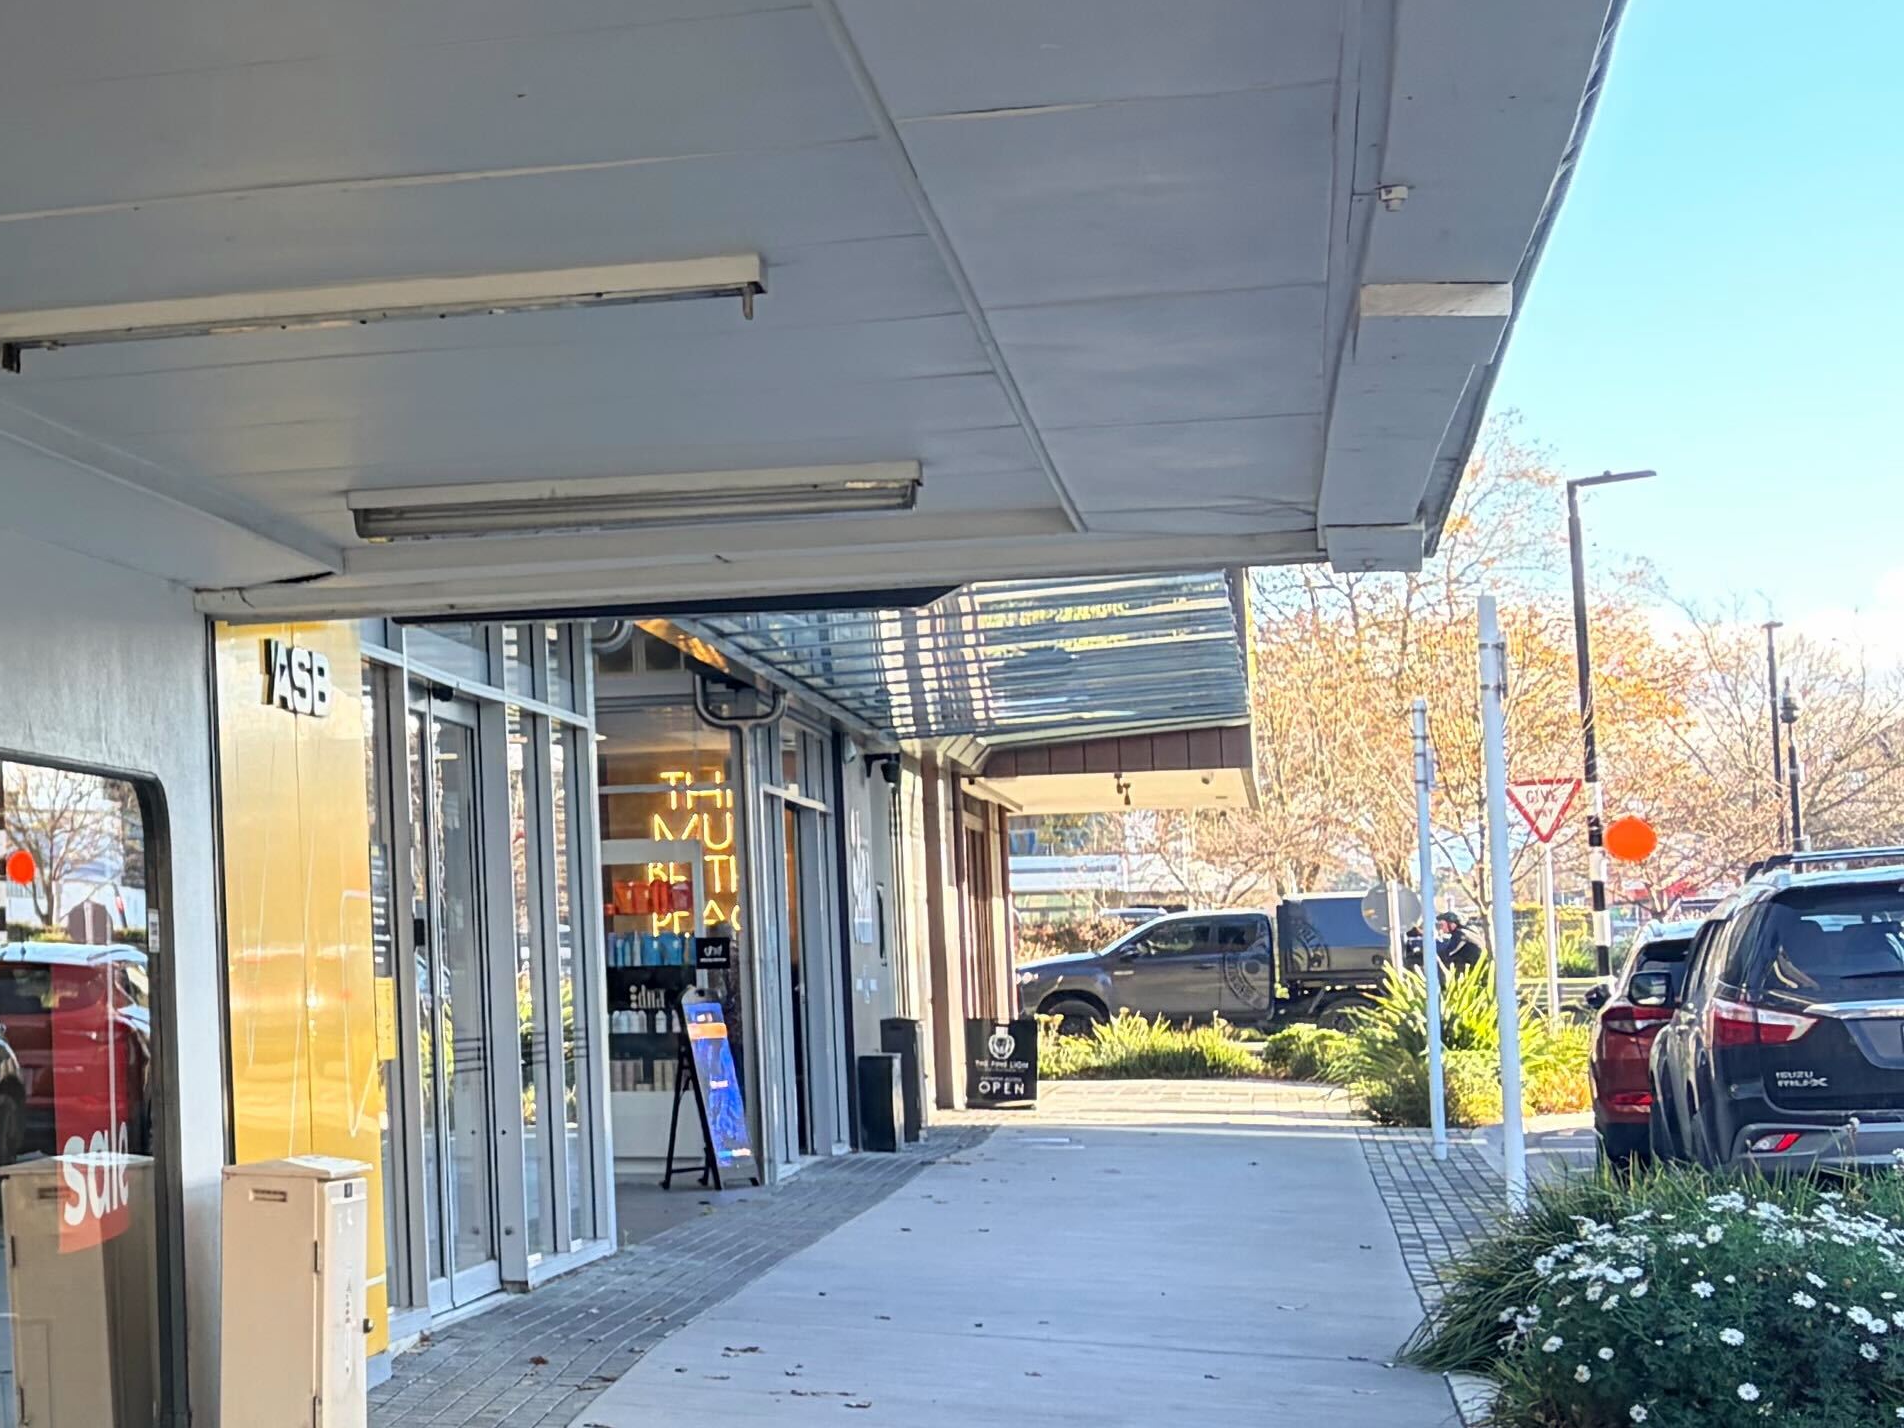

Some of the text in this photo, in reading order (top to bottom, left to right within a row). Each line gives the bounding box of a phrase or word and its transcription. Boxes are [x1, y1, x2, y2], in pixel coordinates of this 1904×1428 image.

[270, 640, 332, 717] ASB
[978, 1081, 1025, 1095] OPEN
[63, 1121, 129, 1226] sale
